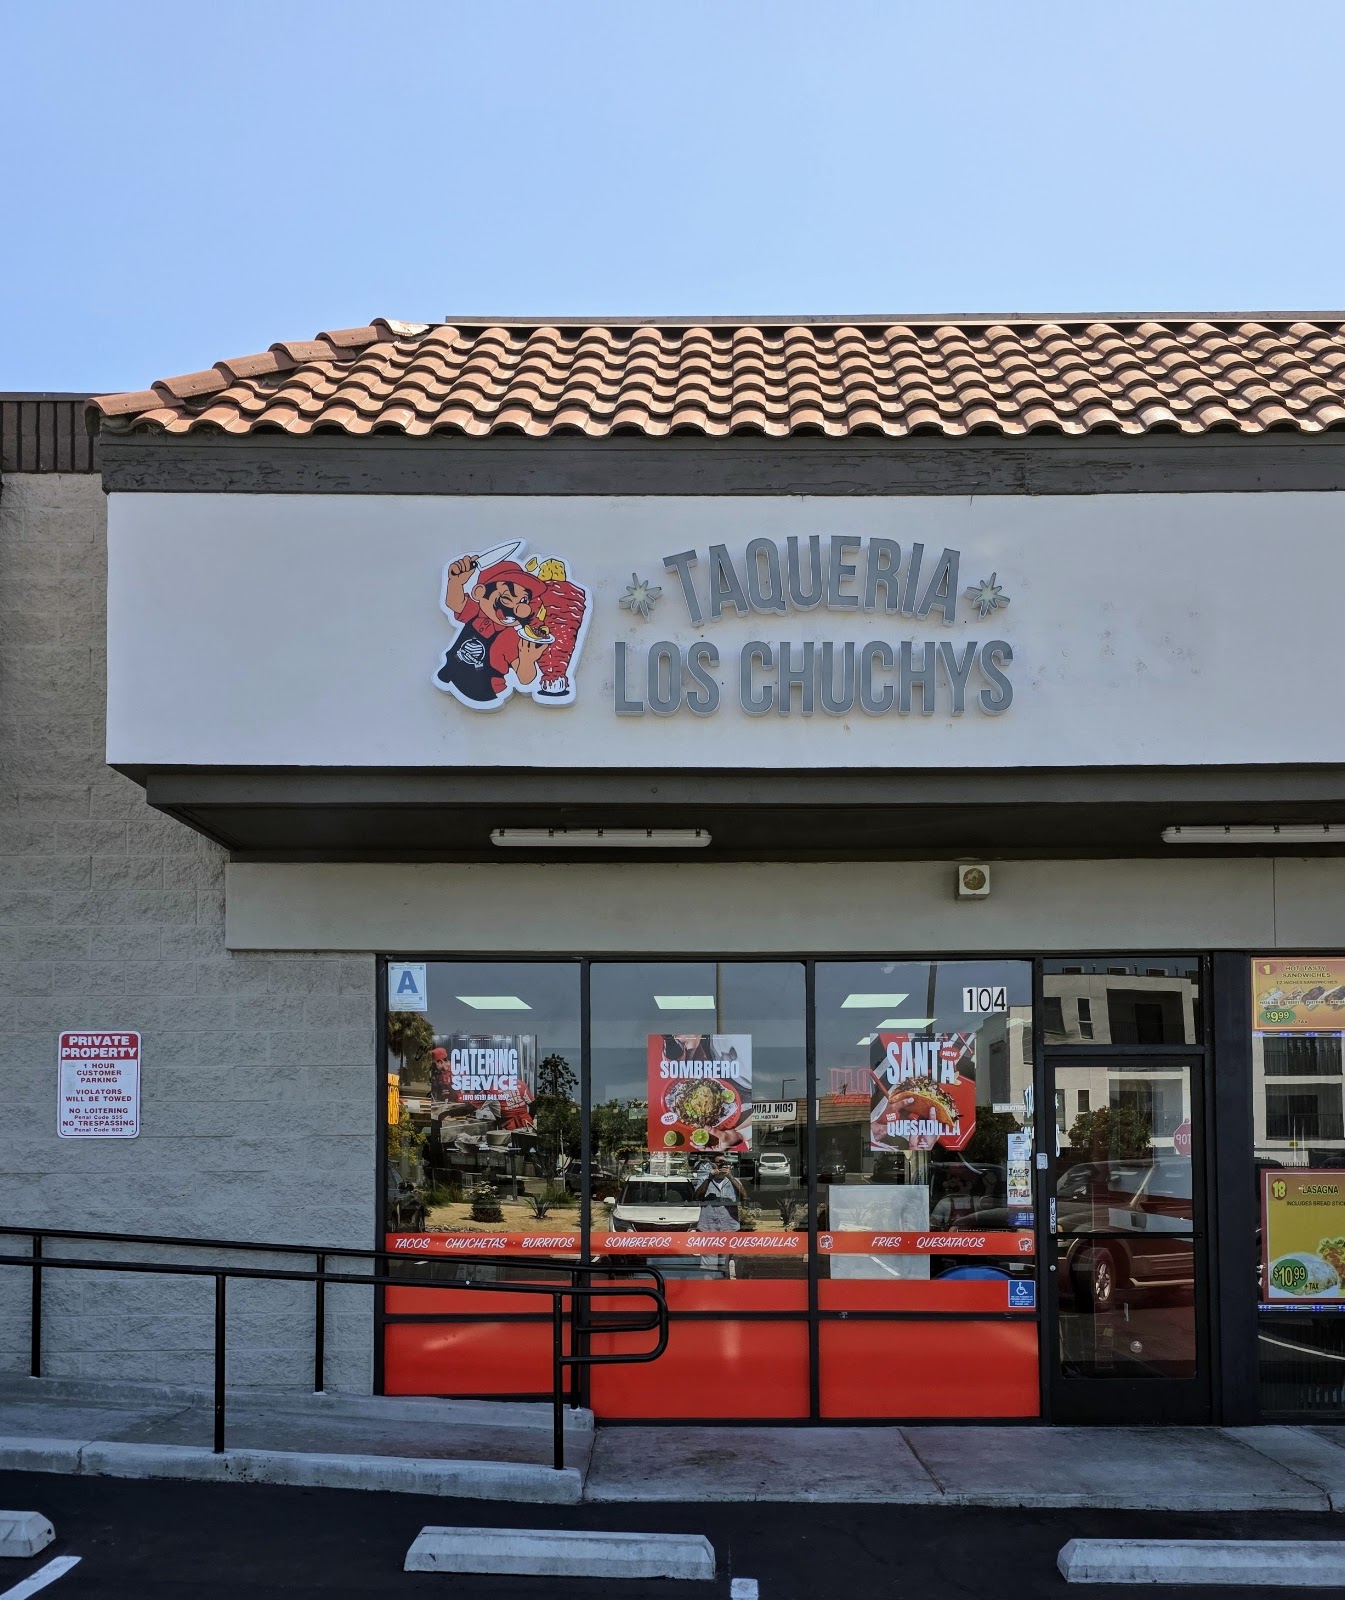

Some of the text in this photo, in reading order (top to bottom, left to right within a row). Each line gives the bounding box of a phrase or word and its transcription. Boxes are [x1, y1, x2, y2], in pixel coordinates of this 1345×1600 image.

[663, 534, 962, 626] TAQUERIA
[613, 640, 1014, 717] LOS CHUCHYS
[1263, 965, 1271, 975] 1
[396, 970, 419, 994] A
[966, 988, 1006, 1011] 104
[1266, 1011, 1290, 1023] $9.99
[69, 1036, 130, 1046] PRIVATE
[61, 1047, 137, 1057] PROPERTY
[450, 1048, 518, 1076] CATERING
[660, 1060, 740, 1079] SOMBRERO
[886, 1041, 956, 1085] SANTA
[451, 1075, 518, 1091] SERVICE
[886, 1120, 961, 1137] QUESADILLA
[1272, 1180, 1286, 1198] 18
[1302, 1185, 1339, 1194] LASAGNA
[394, 1236, 986, 1249] TACOS CHUCHETAS BURRITOS SOMBREROS SANTAS QUESADILLAS FRIES QUESATACOS
[1273, 1266, 1306, 1287] $10.99
[1309, 1282, 1319, 1290] TAX
